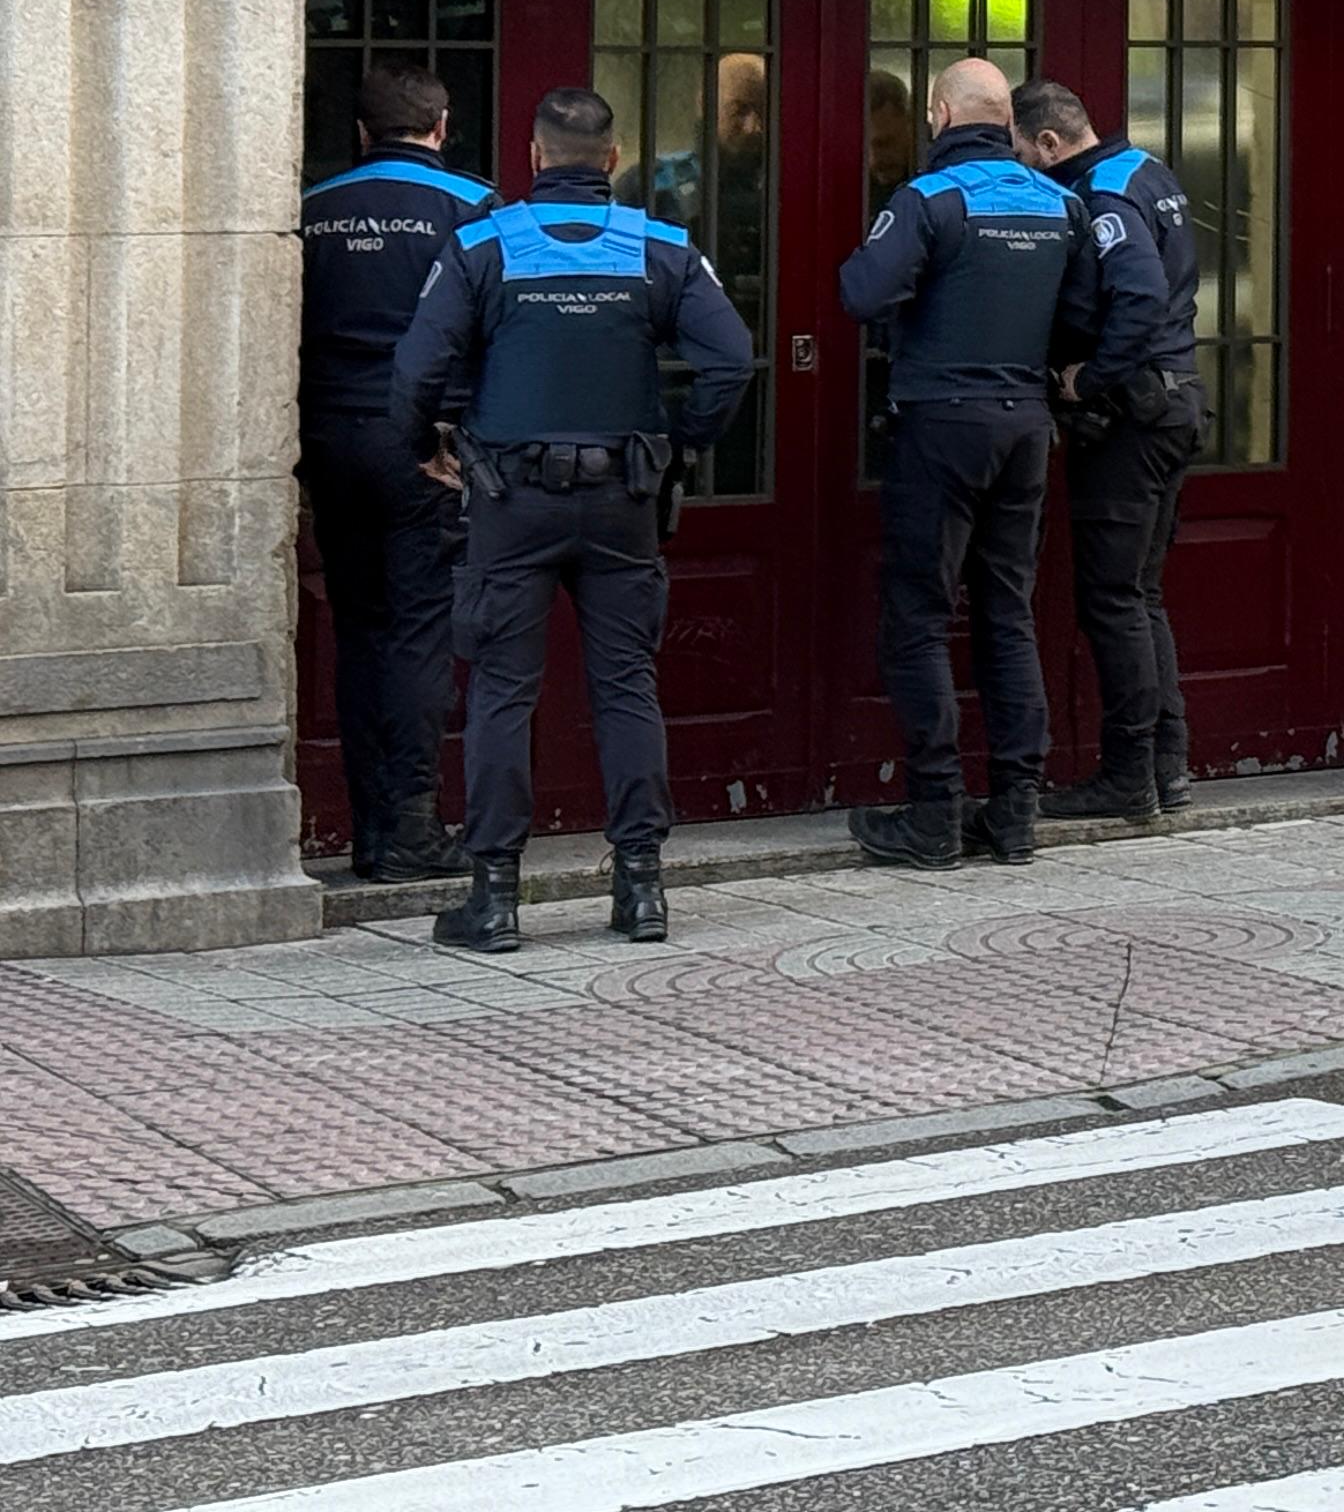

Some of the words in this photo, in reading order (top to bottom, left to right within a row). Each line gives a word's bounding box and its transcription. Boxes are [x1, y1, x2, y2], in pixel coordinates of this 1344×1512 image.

[381, 217, 437, 236] LOCAL
[346, 237, 385, 252] VIGO
[587, 291, 632, 303] LOCAL
[556, 304, 598, 314] VIGO
